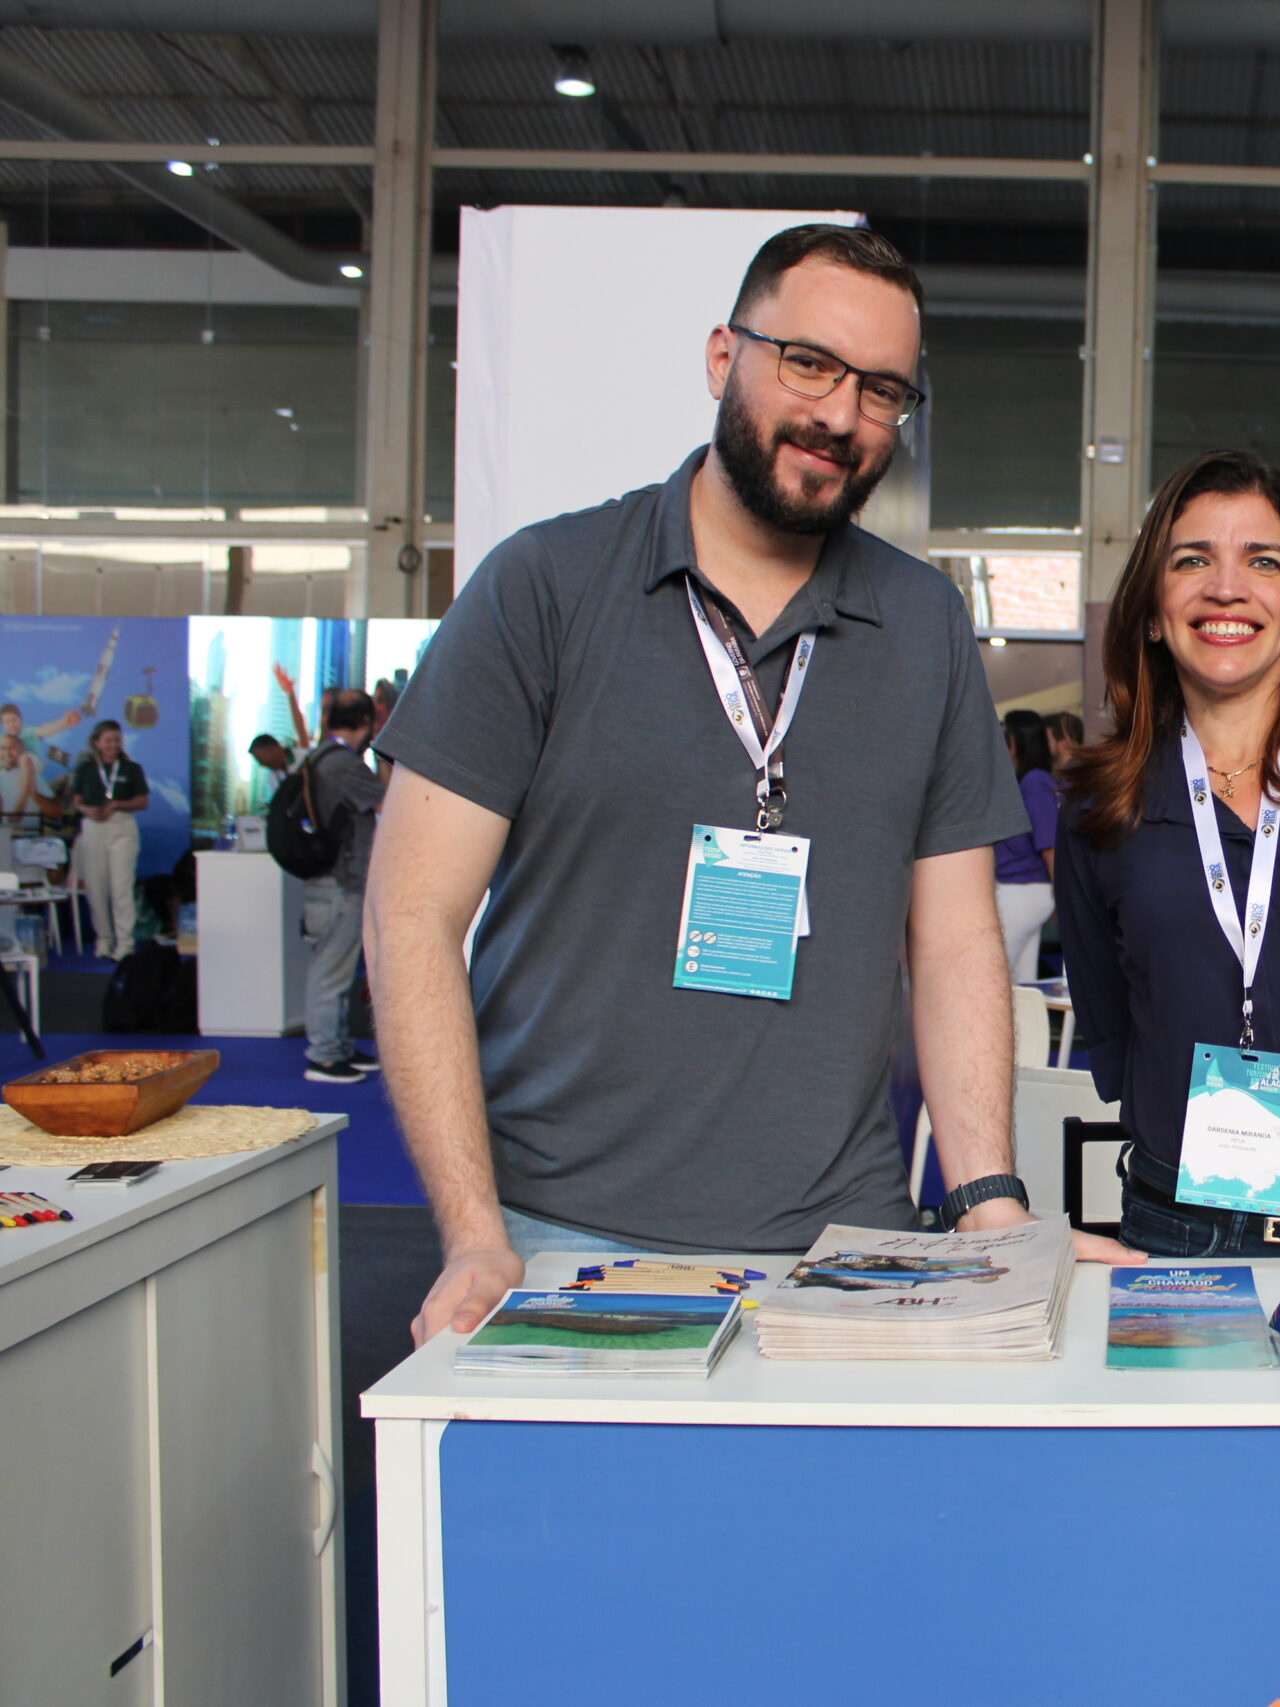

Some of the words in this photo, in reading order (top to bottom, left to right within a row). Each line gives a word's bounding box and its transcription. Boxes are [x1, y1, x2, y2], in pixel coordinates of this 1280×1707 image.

[1207, 1125, 1240, 1135] GARDENIA
[1240, 1130, 1272, 1139] MIRANDA
[1148, 1279, 1214, 1287] CHAMADO
